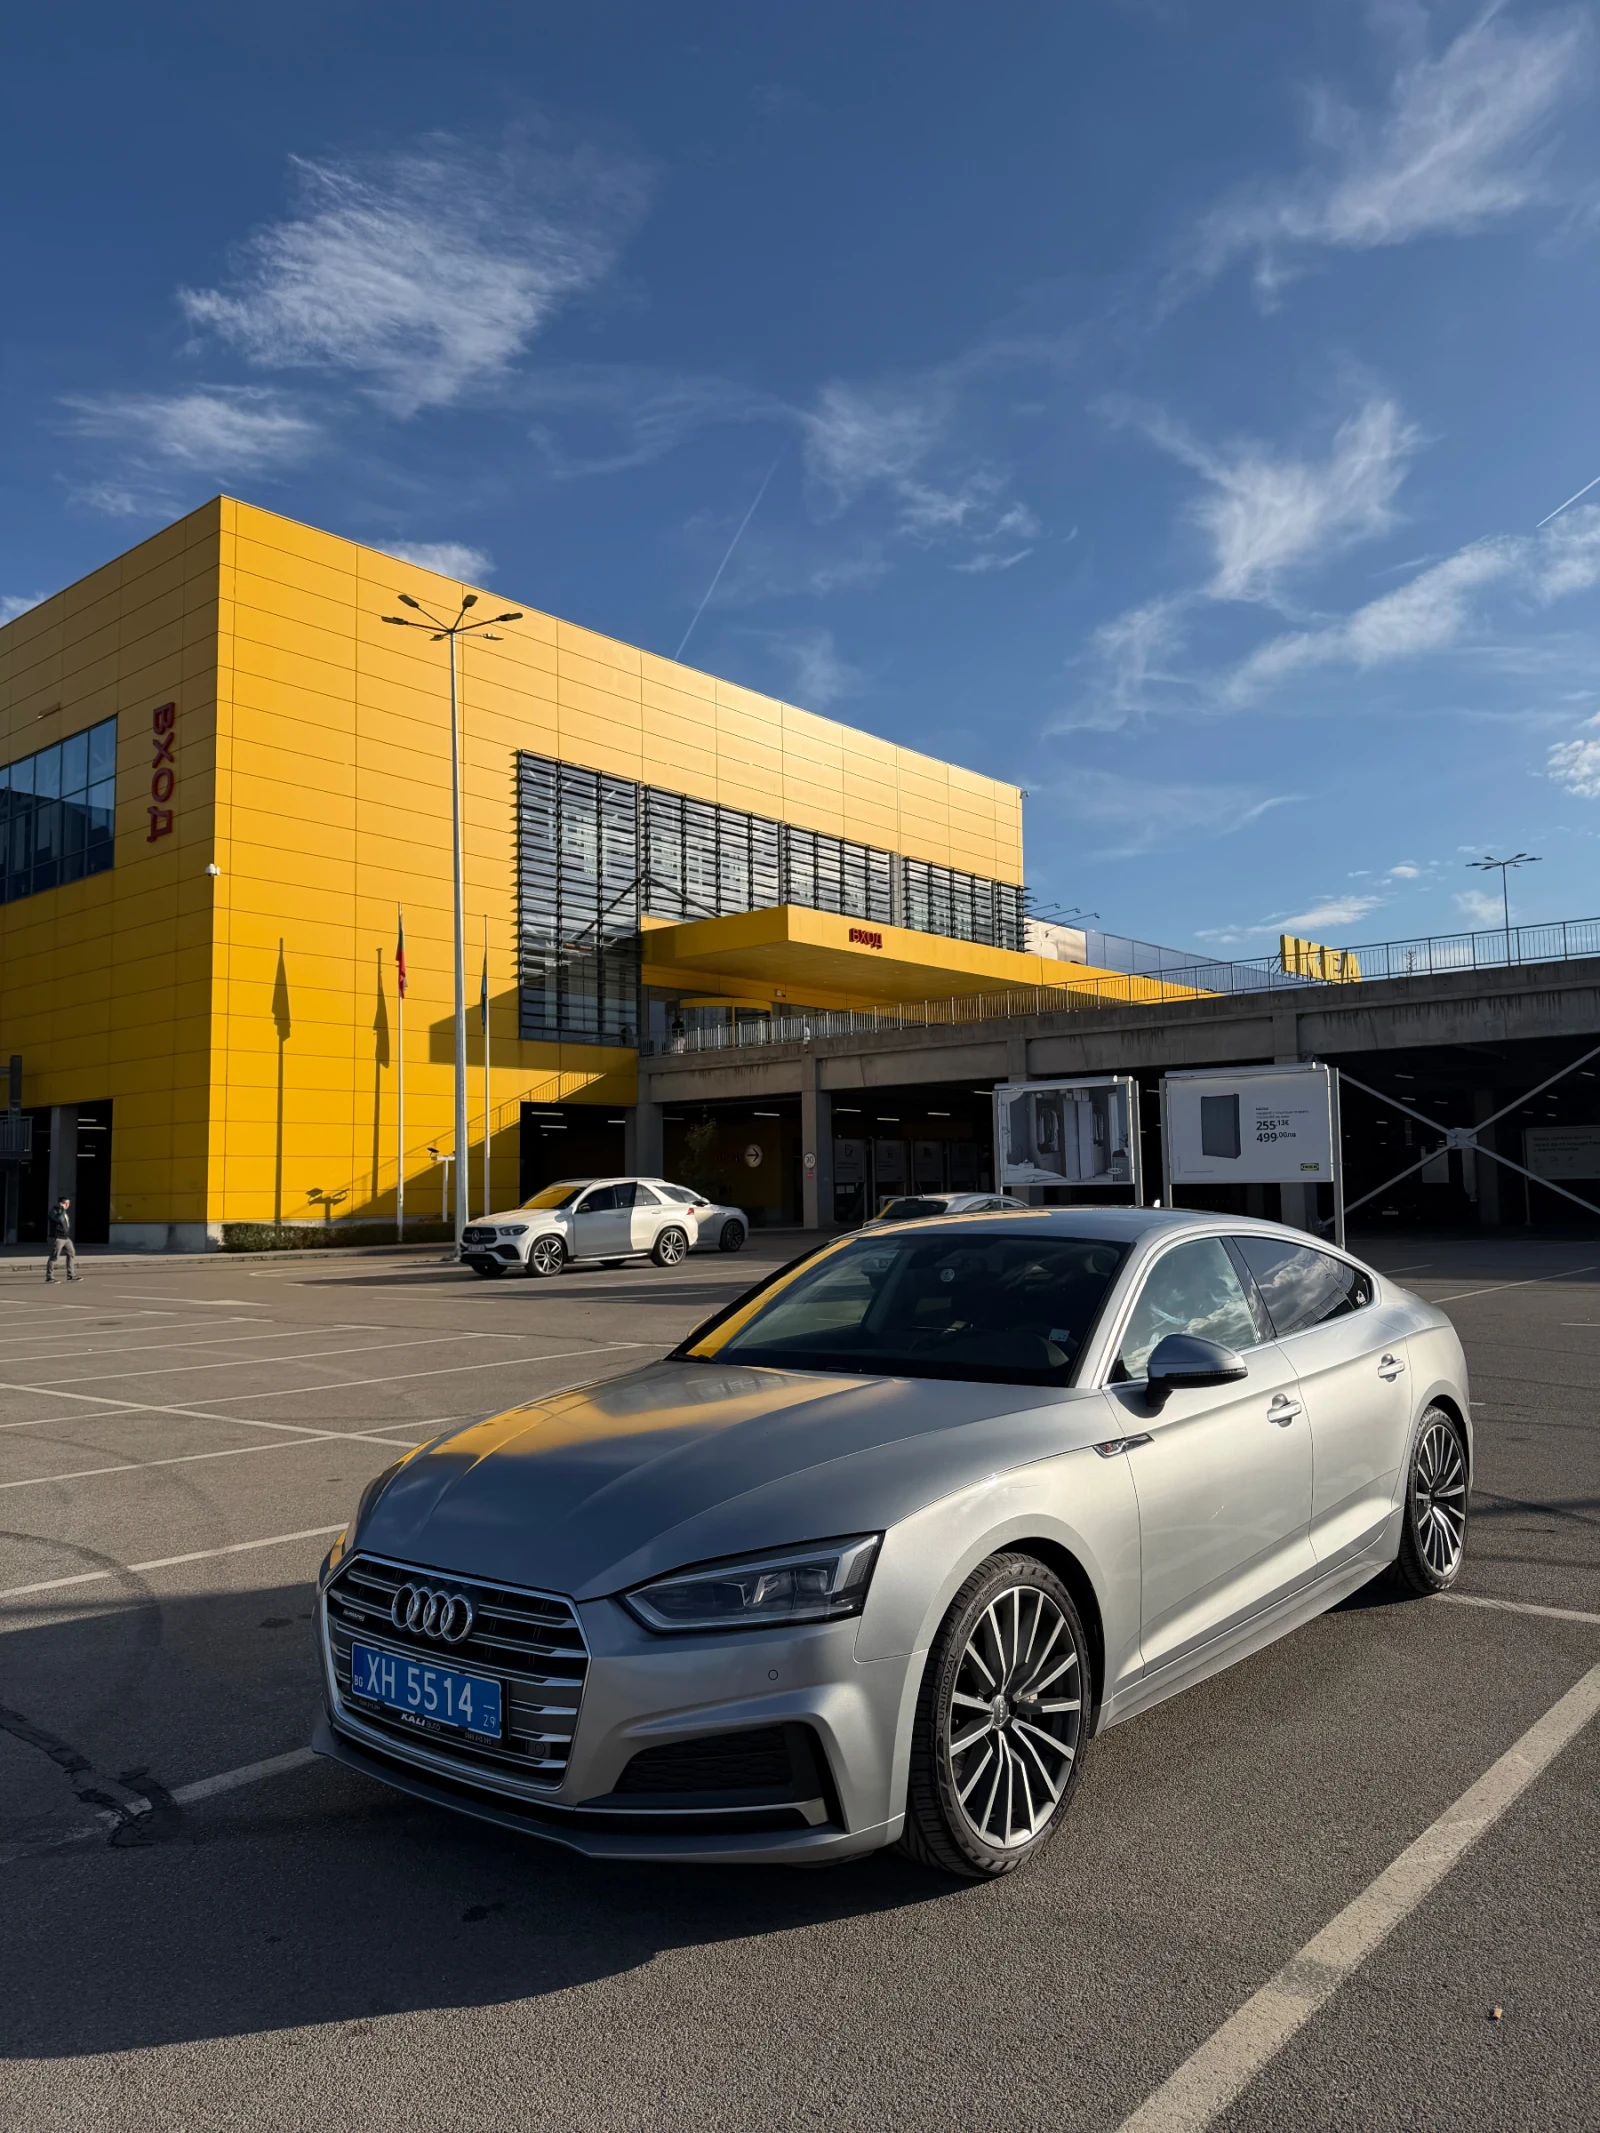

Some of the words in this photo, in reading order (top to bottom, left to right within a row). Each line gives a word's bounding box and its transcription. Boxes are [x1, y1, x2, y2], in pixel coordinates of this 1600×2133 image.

[147, 702, 175, 842] ВХОД
[849, 928, 882, 950] ВХОД
[1280, 934, 1362, 984] IKEA
[354, 1675, 363, 1687] BG
[367, 1654, 395, 1699] XH
[407, 1666, 472, 1722] 5514
[939, 1652, 957, 1720] UNIROYAL
[401, 1713, 426, 1726] KALI
[483, 1714, 496, 1728] 29
